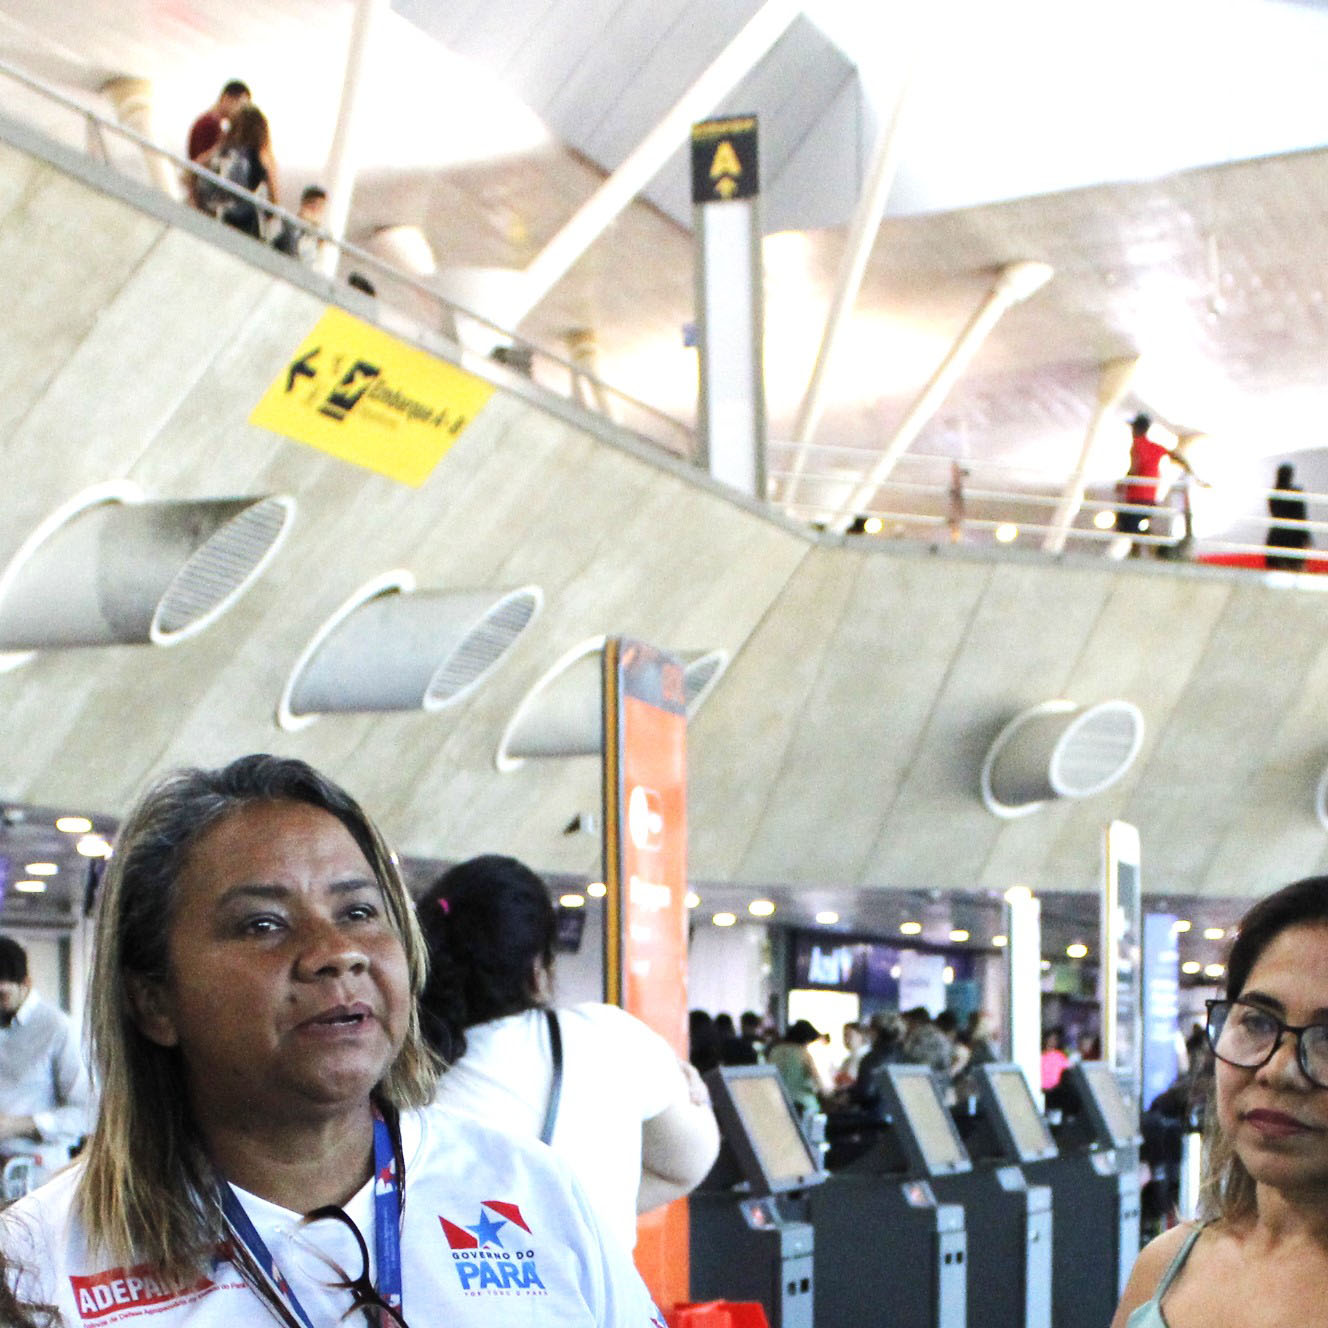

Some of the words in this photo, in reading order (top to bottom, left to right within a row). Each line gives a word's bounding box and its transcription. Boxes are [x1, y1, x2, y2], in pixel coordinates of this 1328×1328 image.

[709, 141, 742, 178] A
[452, 1250, 511, 1260] GOVERNO
[516, 1249, 535, 1260] DO
